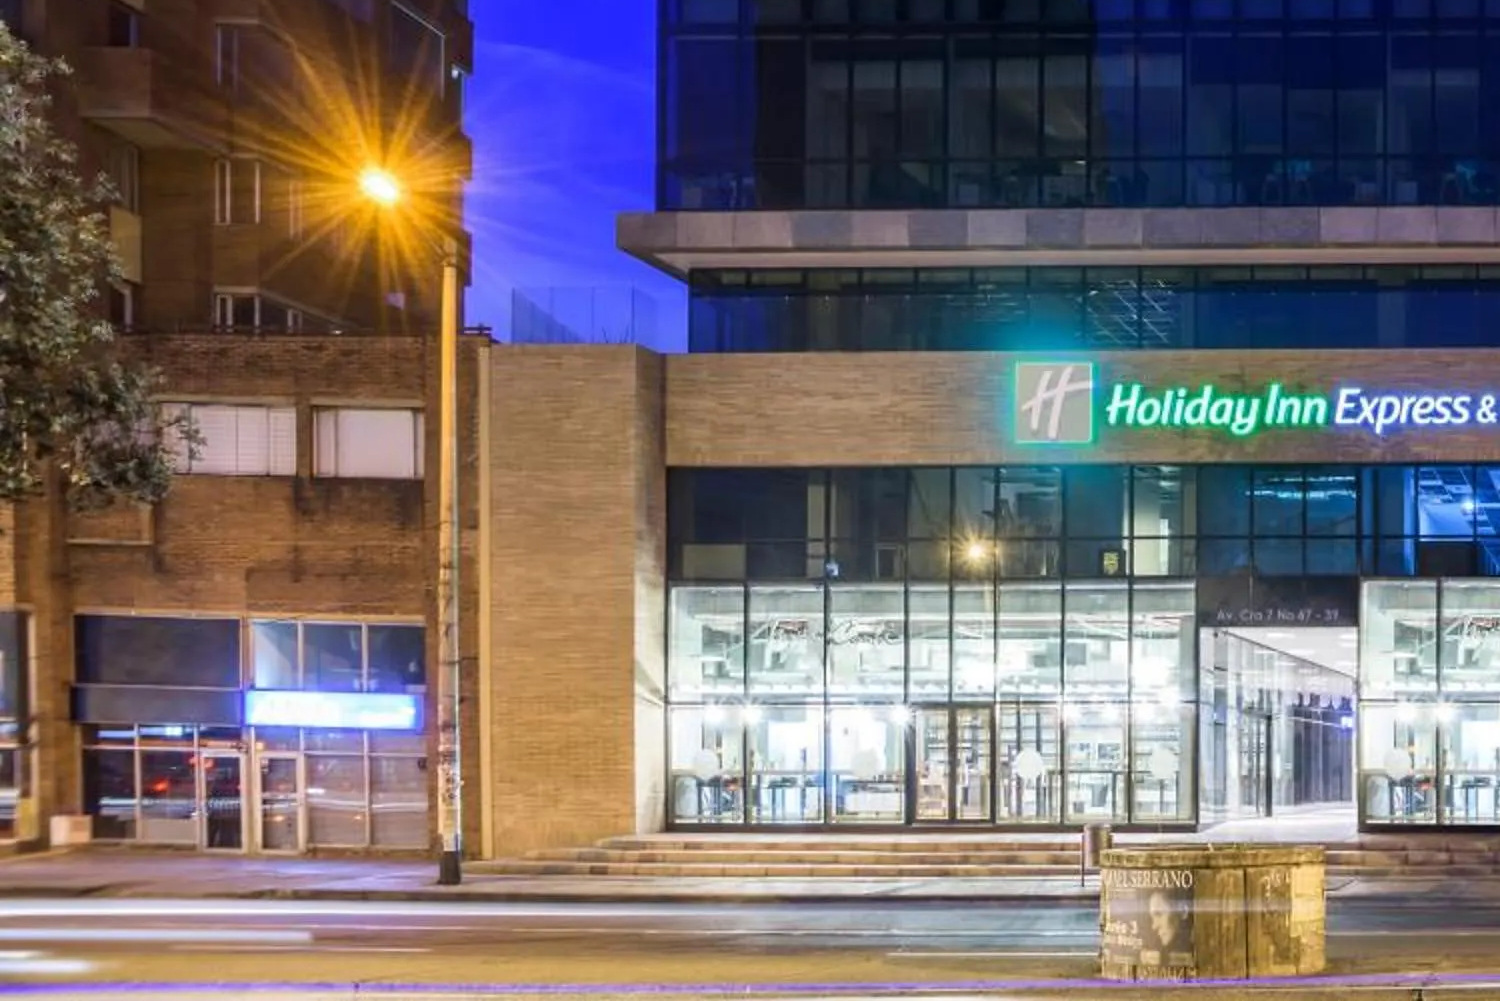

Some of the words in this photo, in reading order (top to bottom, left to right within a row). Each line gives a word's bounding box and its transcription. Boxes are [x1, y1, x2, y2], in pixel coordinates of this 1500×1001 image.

[1106, 383, 1260, 435] Holiday
[1264, 384, 1327, 425] Inn
[1335, 388, 1471, 434] Express
[1476, 394, 1497, 424] &
[1239, 608, 1263, 621] Cra
[1267, 608, 1274, 621] 7
[1130, 869, 1193, 888] SERRANO
